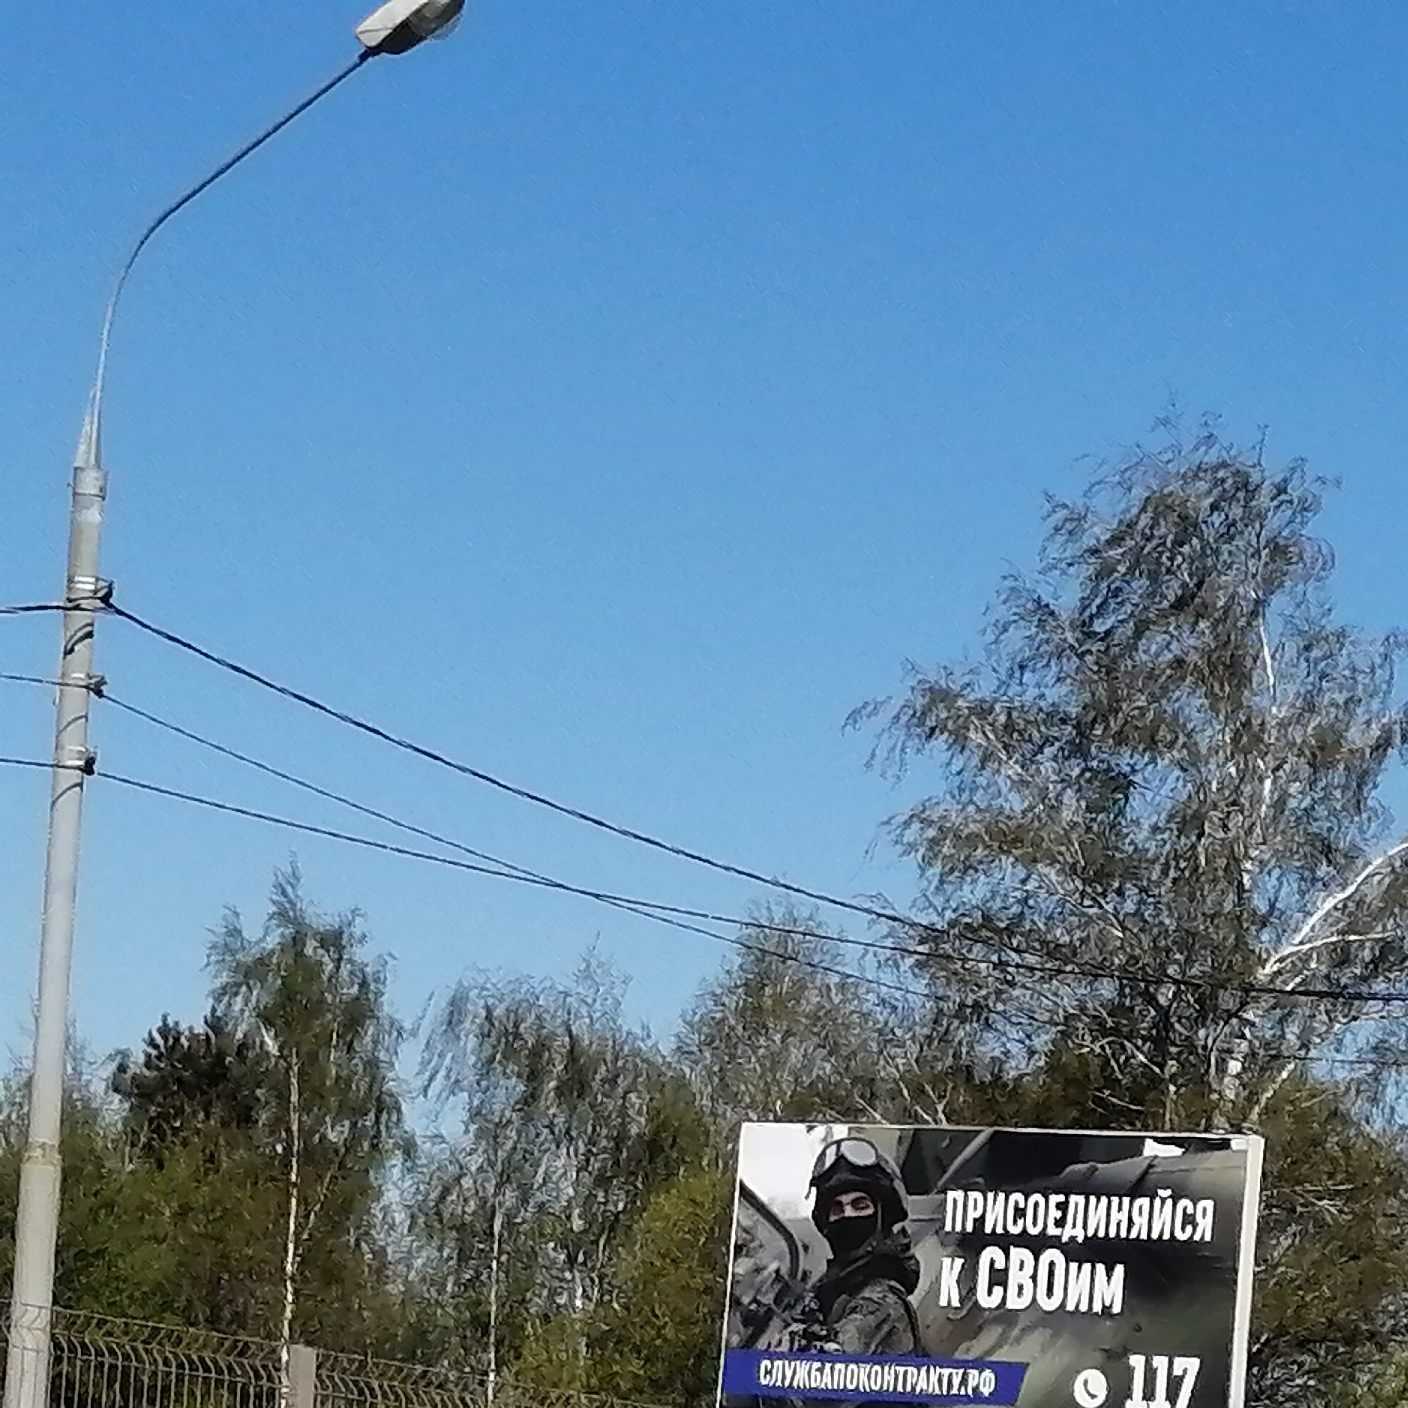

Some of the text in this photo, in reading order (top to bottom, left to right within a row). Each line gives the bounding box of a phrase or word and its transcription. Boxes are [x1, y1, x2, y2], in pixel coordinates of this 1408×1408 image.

[945, 1188, 1215, 1242] ПРИСОЕДИНЯЙСЯ
[977, 1246, 1125, 1315] СВОим
[759, 1360, 996, 1398] СЛУЖБАПОКОНТРАКТУ.РФ
